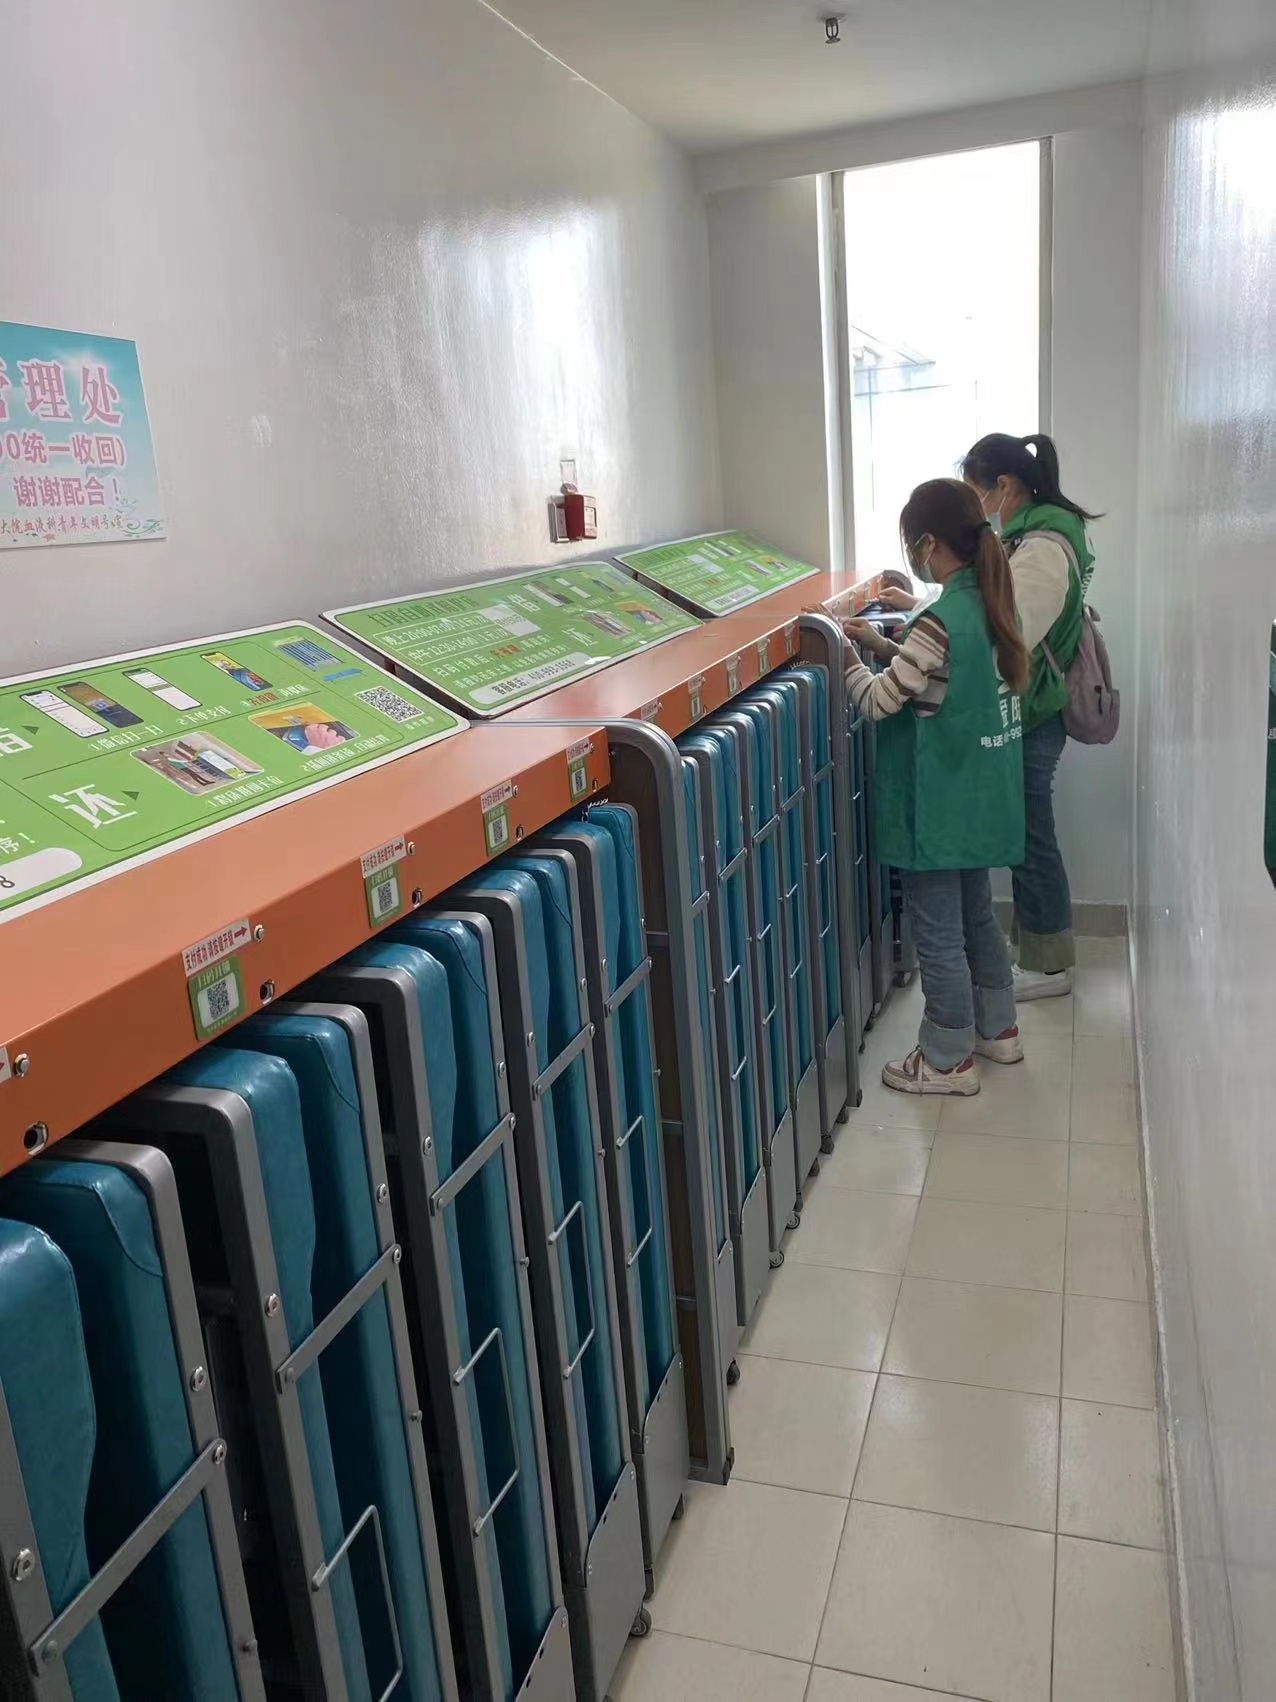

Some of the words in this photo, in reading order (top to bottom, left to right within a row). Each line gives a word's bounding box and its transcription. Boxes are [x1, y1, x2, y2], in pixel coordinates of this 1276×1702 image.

[0, 432, 125, 466] 0统一收回)
[12, 476, 120, 507] 谢谢配合！
[48, 784, 139, 829] 还
